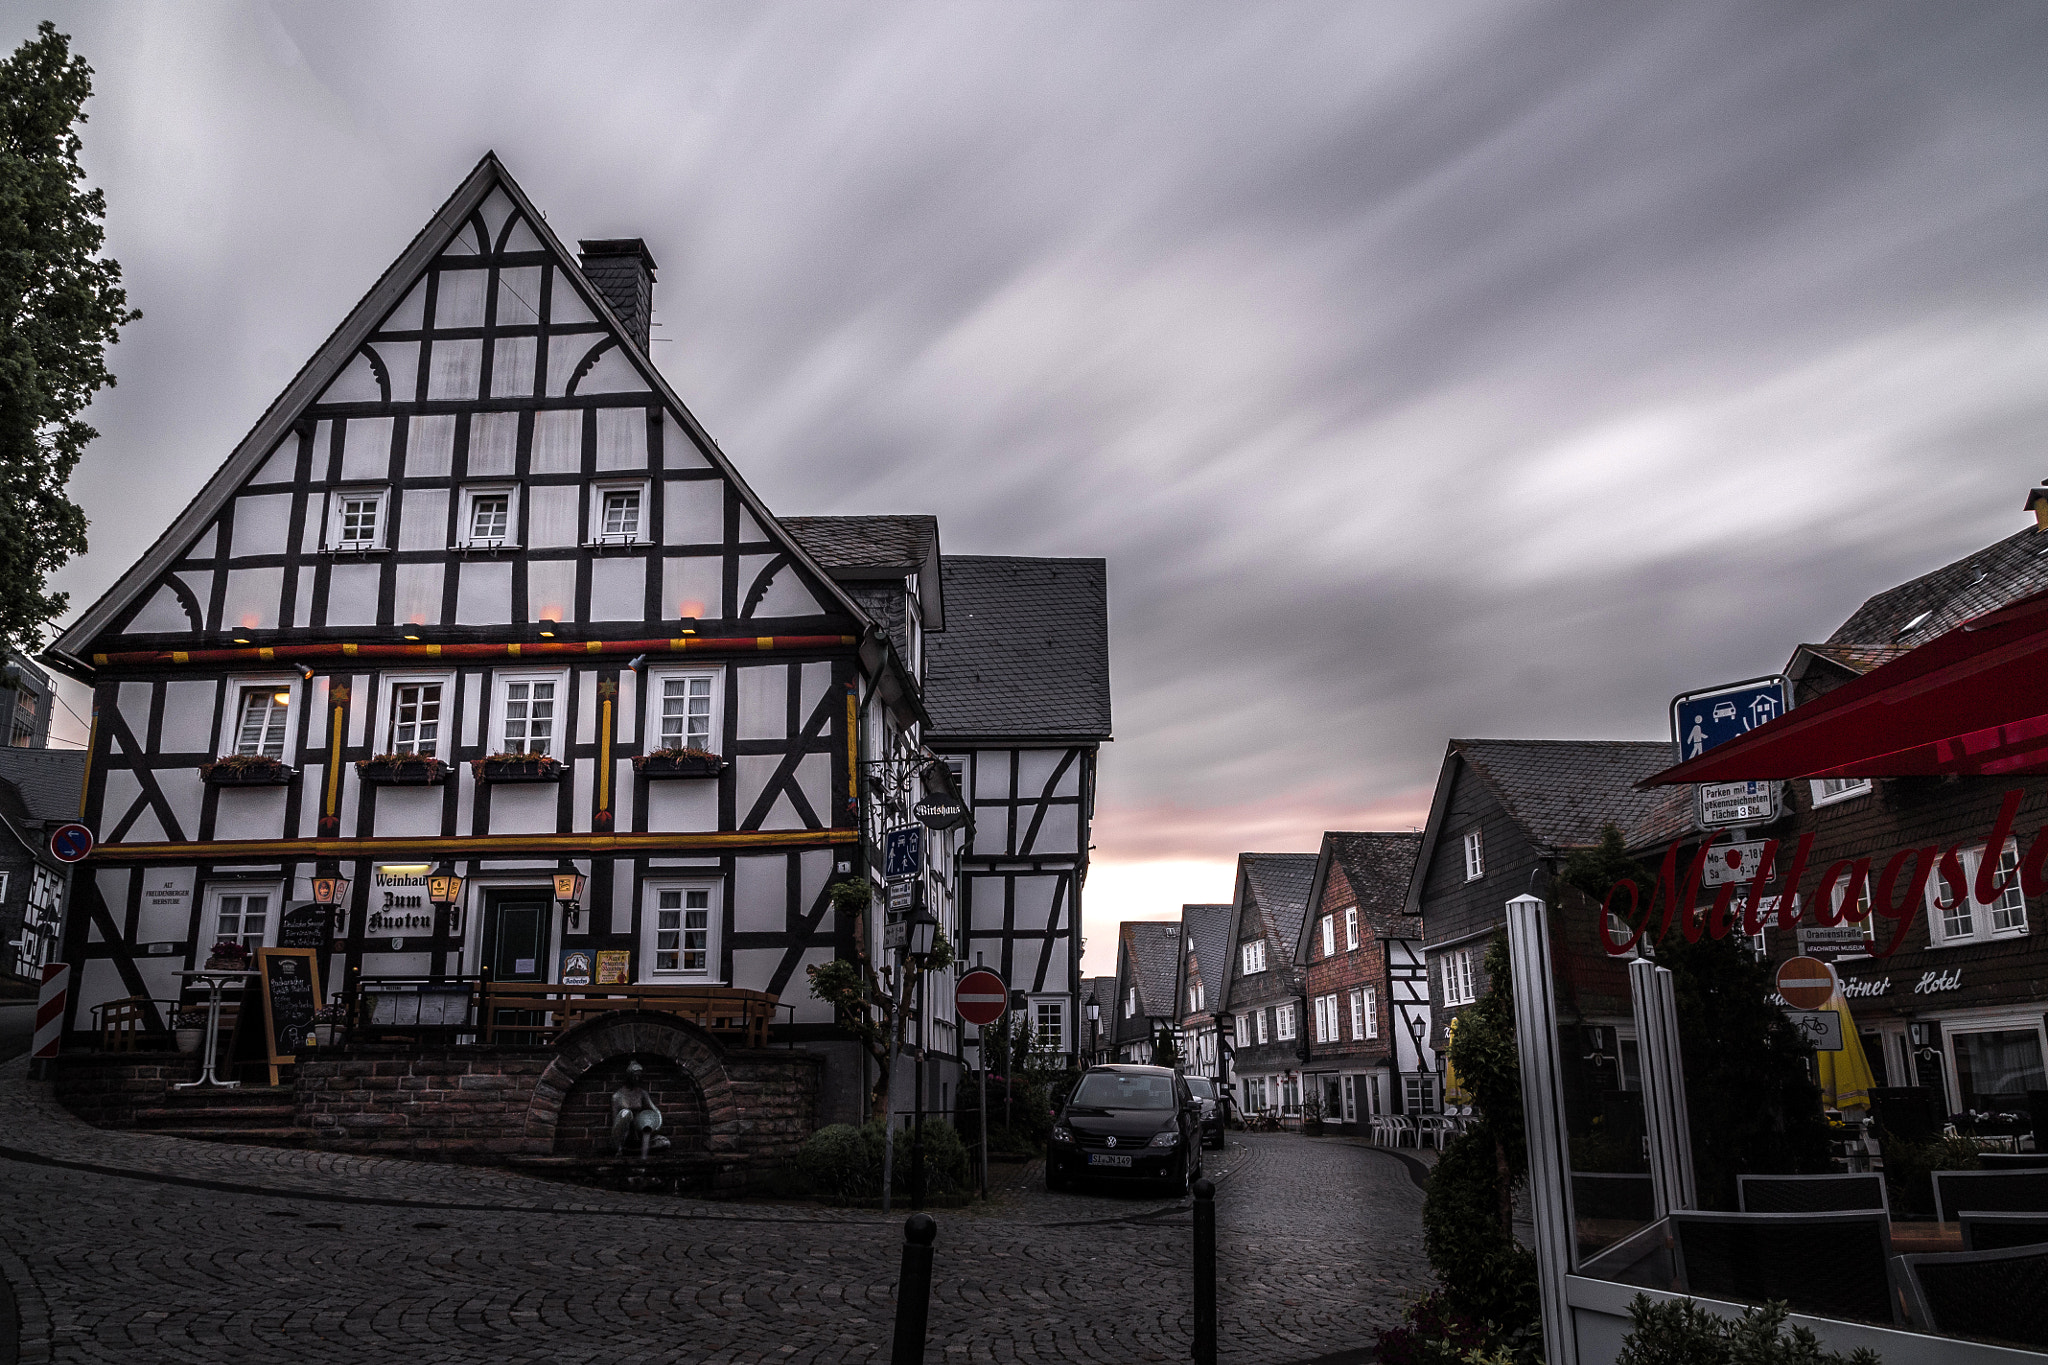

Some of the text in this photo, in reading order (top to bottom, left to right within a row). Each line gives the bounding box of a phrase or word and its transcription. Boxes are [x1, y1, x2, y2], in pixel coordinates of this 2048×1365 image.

[1706, 788, 1731, 798] Parken
[1734, 785, 1746, 794] mit
[916, 804, 961, 816] Wirtshaus
[1704, 795, 1768, 812] gekennzeichneten
[1712, 806, 1762, 820] Flächen 3 Std.
[376, 874, 428, 887] Weinhau
[1710, 869, 1720, 879] Sa
[382, 892, 422, 912] Zum
[368, 911, 430, 932] Knoten
[1806, 929, 1861, 938] Oranienstraße
[1914, 968, 1962, 994] Hotel
